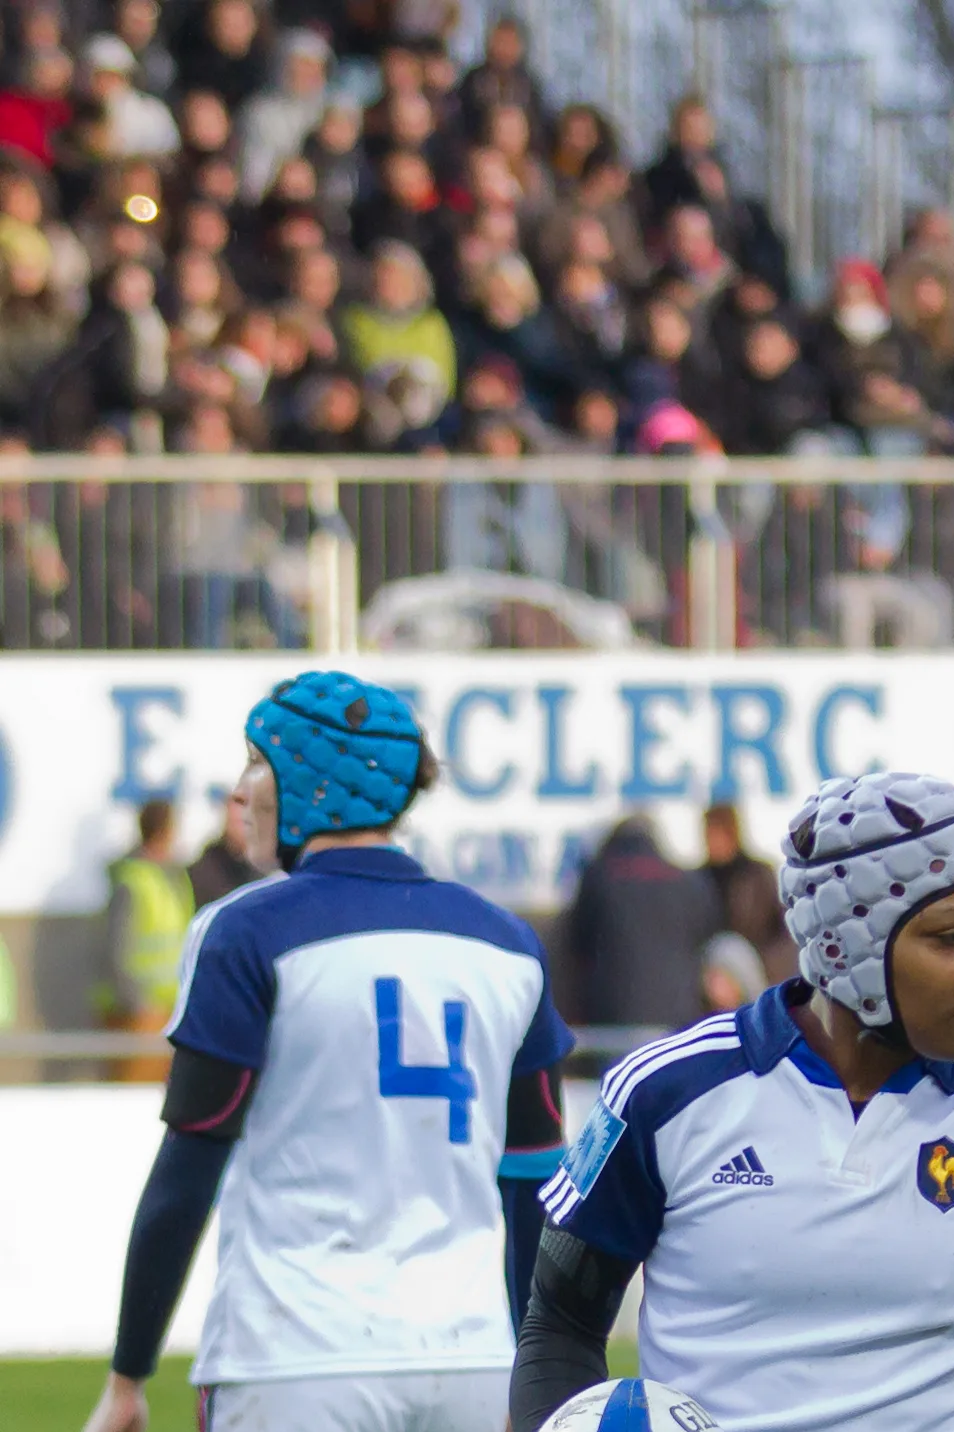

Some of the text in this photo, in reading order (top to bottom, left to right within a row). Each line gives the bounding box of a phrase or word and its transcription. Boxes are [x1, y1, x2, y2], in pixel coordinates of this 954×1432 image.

[400, 682, 885, 799] CLERC
[374, 977, 478, 1144] 4
[712, 1169, 774, 1187] adidas
